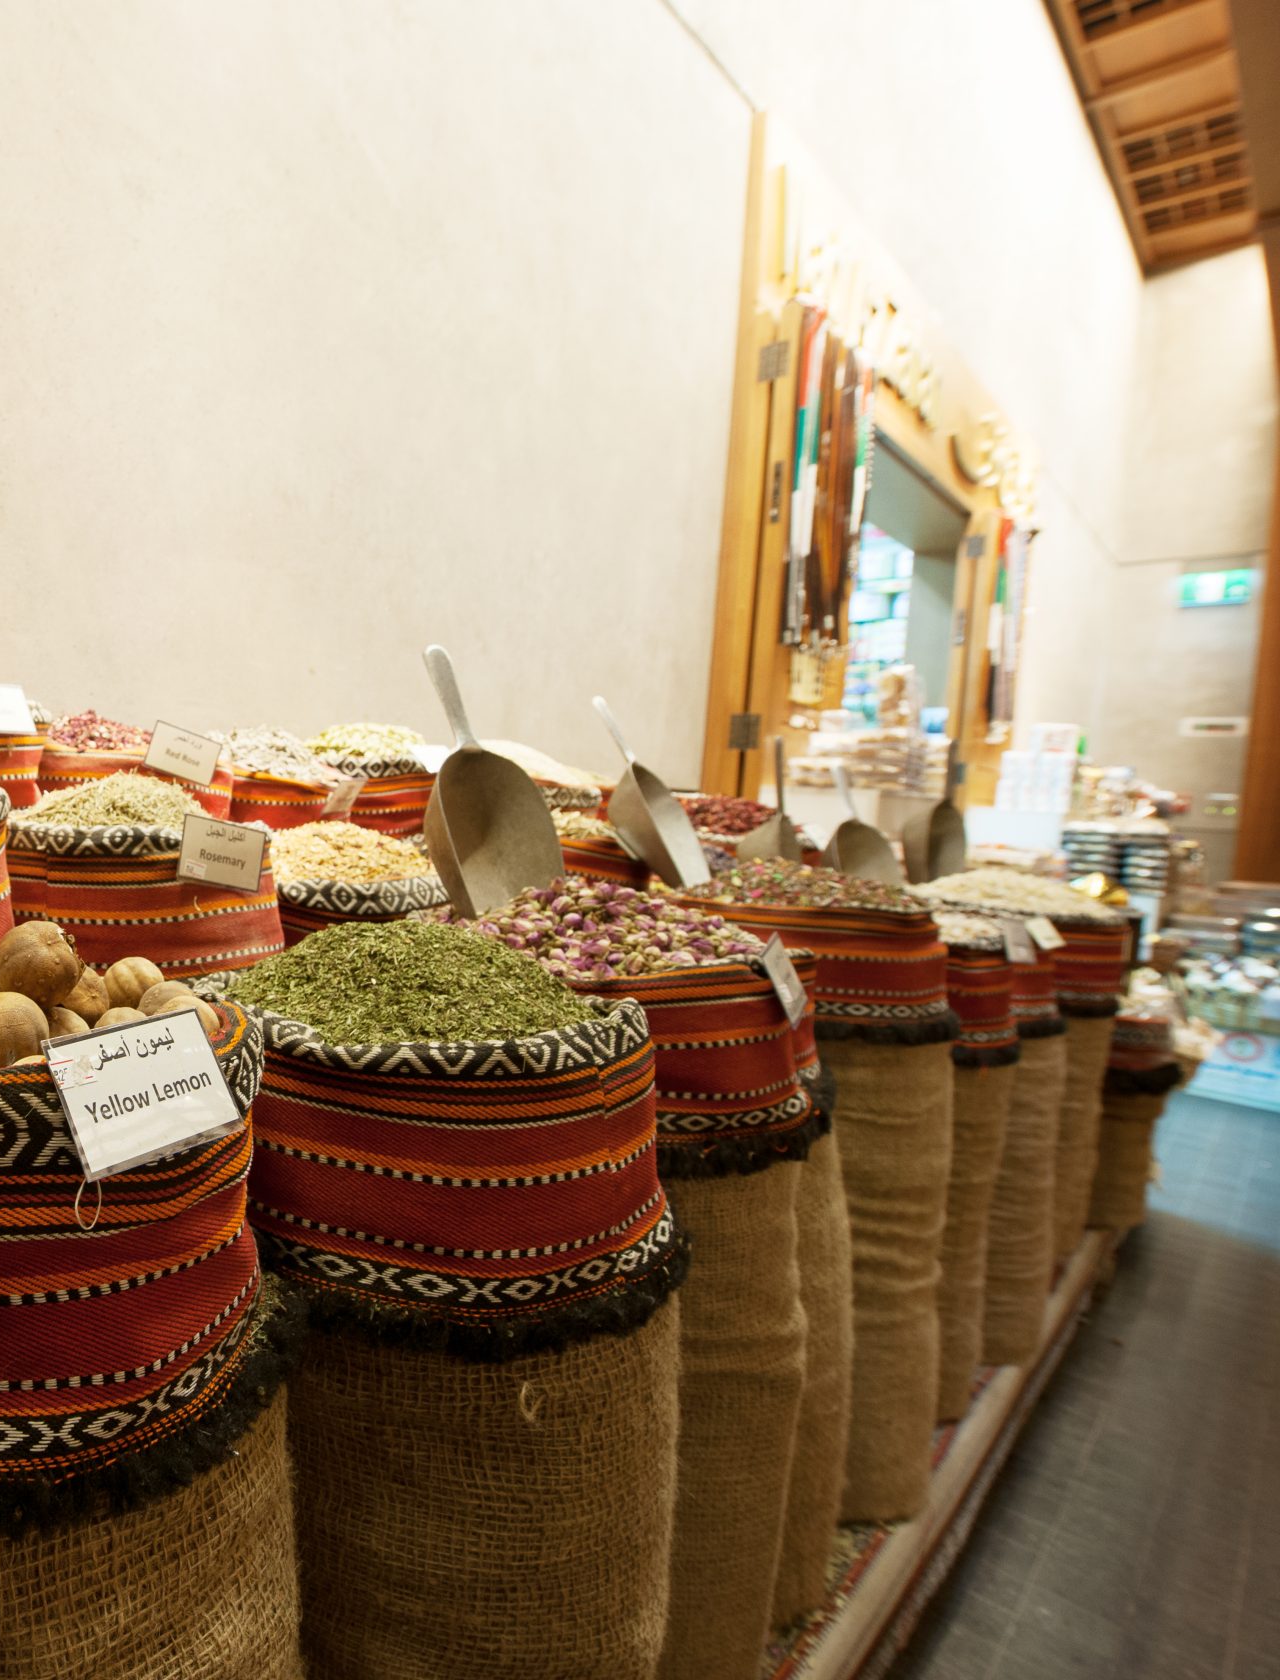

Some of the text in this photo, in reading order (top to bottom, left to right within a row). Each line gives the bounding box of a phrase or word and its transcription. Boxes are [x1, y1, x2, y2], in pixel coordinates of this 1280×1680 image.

[199, 848, 246, 870] Rosemary
[94, 1027, 175, 1071] ليمون أصفر
[84, 1071, 212, 1124] Yellow Lemon
